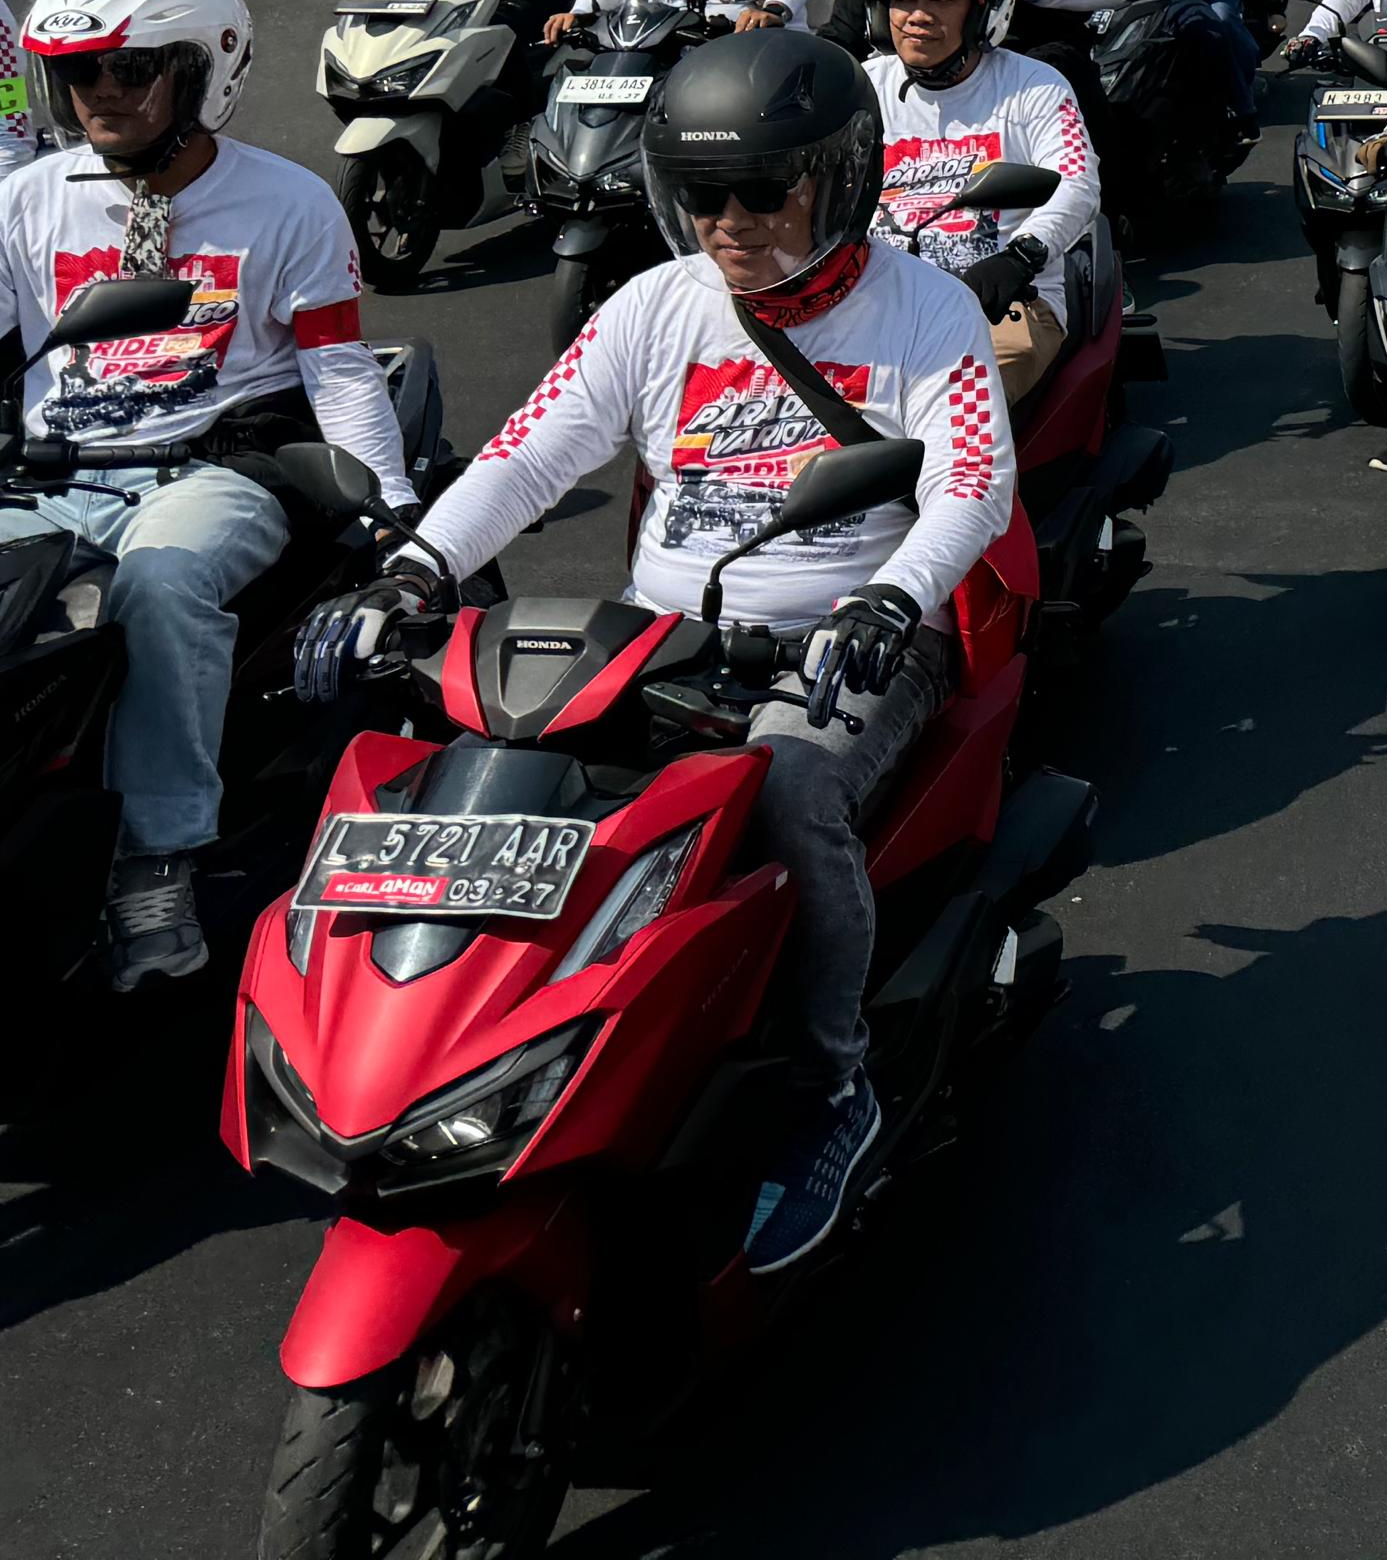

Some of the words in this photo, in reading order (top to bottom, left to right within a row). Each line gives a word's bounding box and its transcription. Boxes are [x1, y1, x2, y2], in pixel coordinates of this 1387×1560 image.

[566, 80, 576, 91] L
[580, 79, 614, 91] 3814
[621, 78, 650, 91] AAS
[1344, 93, 1382, 105] 3983
[680, 131, 742, 142] HONDA
[884, 155, 976, 189] PARADE
[186, 300, 240, 325] 160
[93, 337, 165, 357] RIDE
[709, 420, 808, 457] VARIO
[720, 459, 789, 478] RIDE
[517, 640, 572, 651] HONDA
[328, 823, 349, 862] L
[380, 823, 476, 862] 5721
[494, 826, 578, 868] AAR
